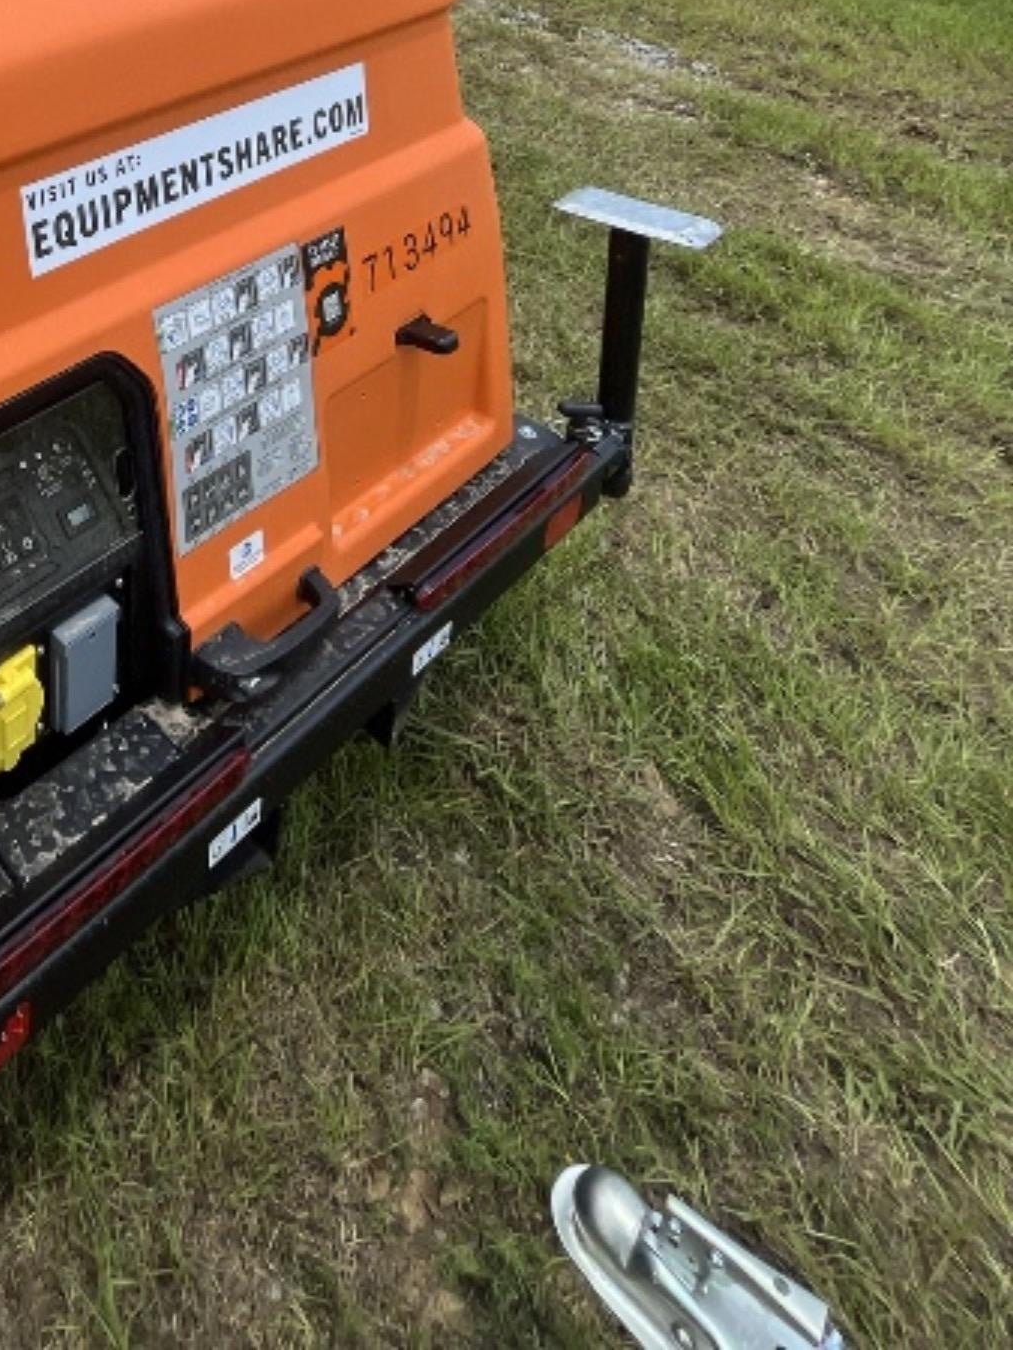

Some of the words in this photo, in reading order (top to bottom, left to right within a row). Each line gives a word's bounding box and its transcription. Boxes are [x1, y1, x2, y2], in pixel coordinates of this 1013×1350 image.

[26, 176, 76, 211] VISIT
[85, 164, 109, 187] US
[115, 154, 142, 178] AT:
[30, 91, 366, 260] EQUIPMENTSHARE.COM
[361, 205, 472, 294] 713494
